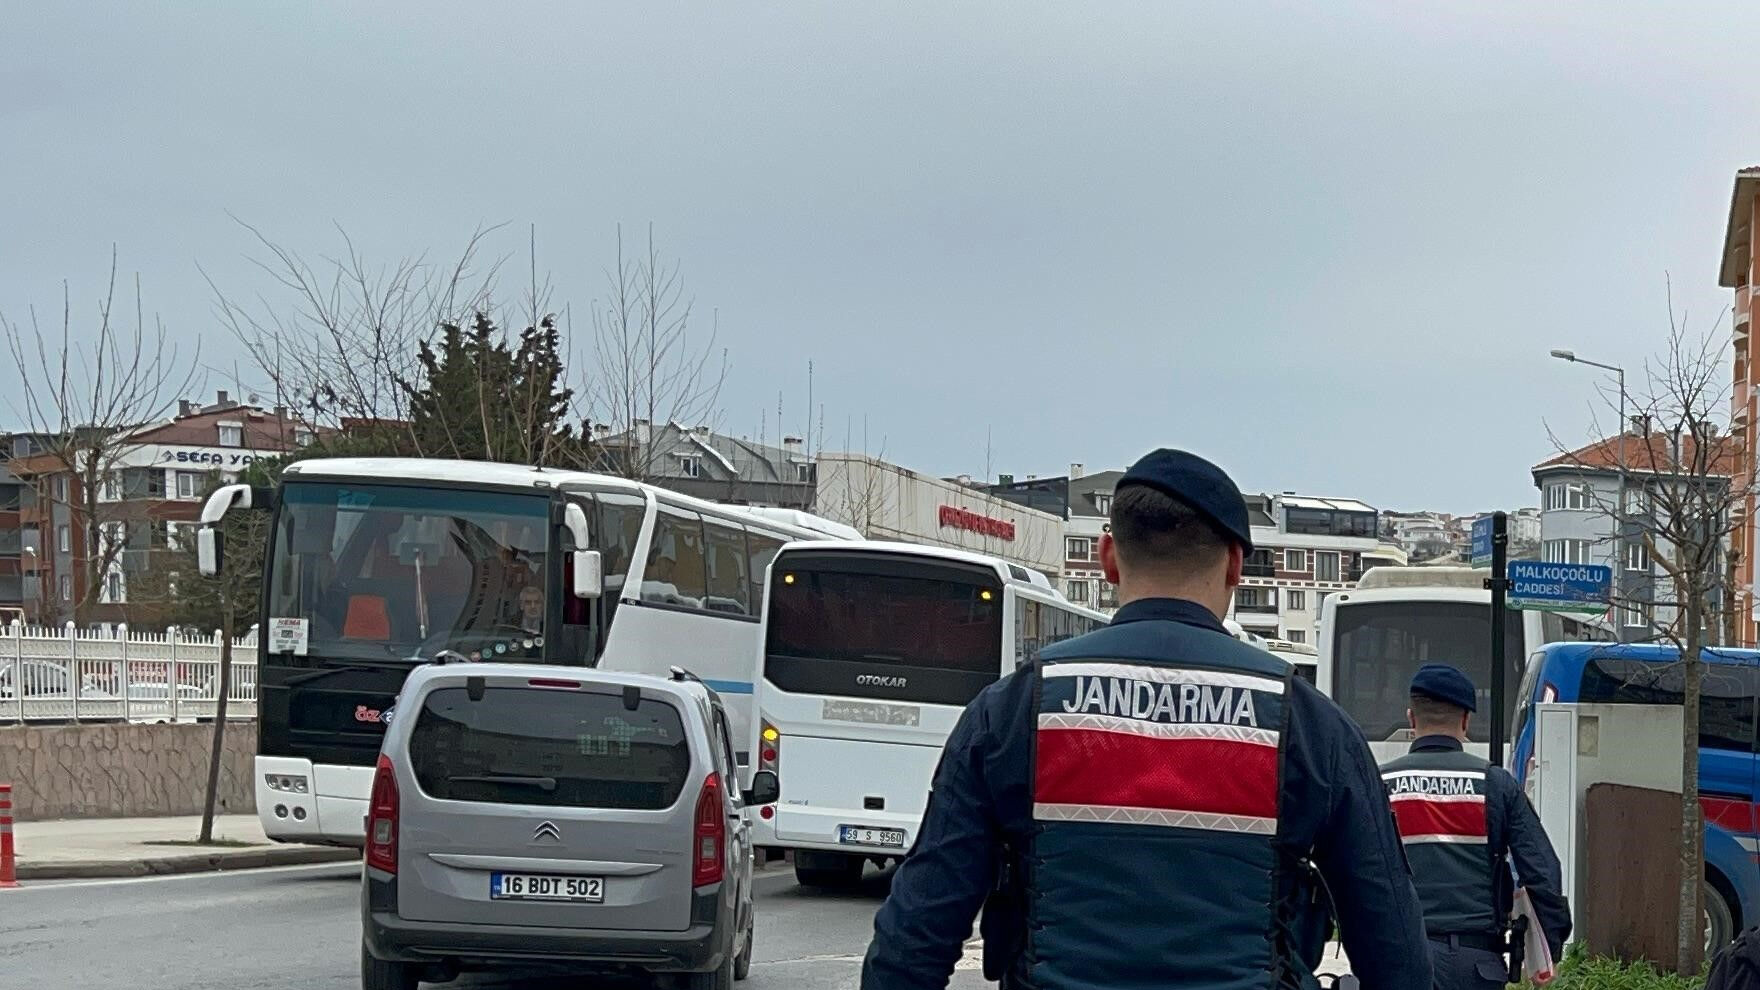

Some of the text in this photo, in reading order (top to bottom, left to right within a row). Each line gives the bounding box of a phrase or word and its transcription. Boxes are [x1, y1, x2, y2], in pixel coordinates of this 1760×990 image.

[176, 451, 223, 464] SEFA
[1515, 565, 1603, 583] MALKOÇOĞLU
[1515, 582, 1564, 595] CADDESİ
[856, 674, 907, 688] OTOKAR
[1062, 676, 1257, 727] JANDARMA
[1391, 776, 1475, 794] JANDARMA
[504, 876, 599, 896] 16 BDT 502
